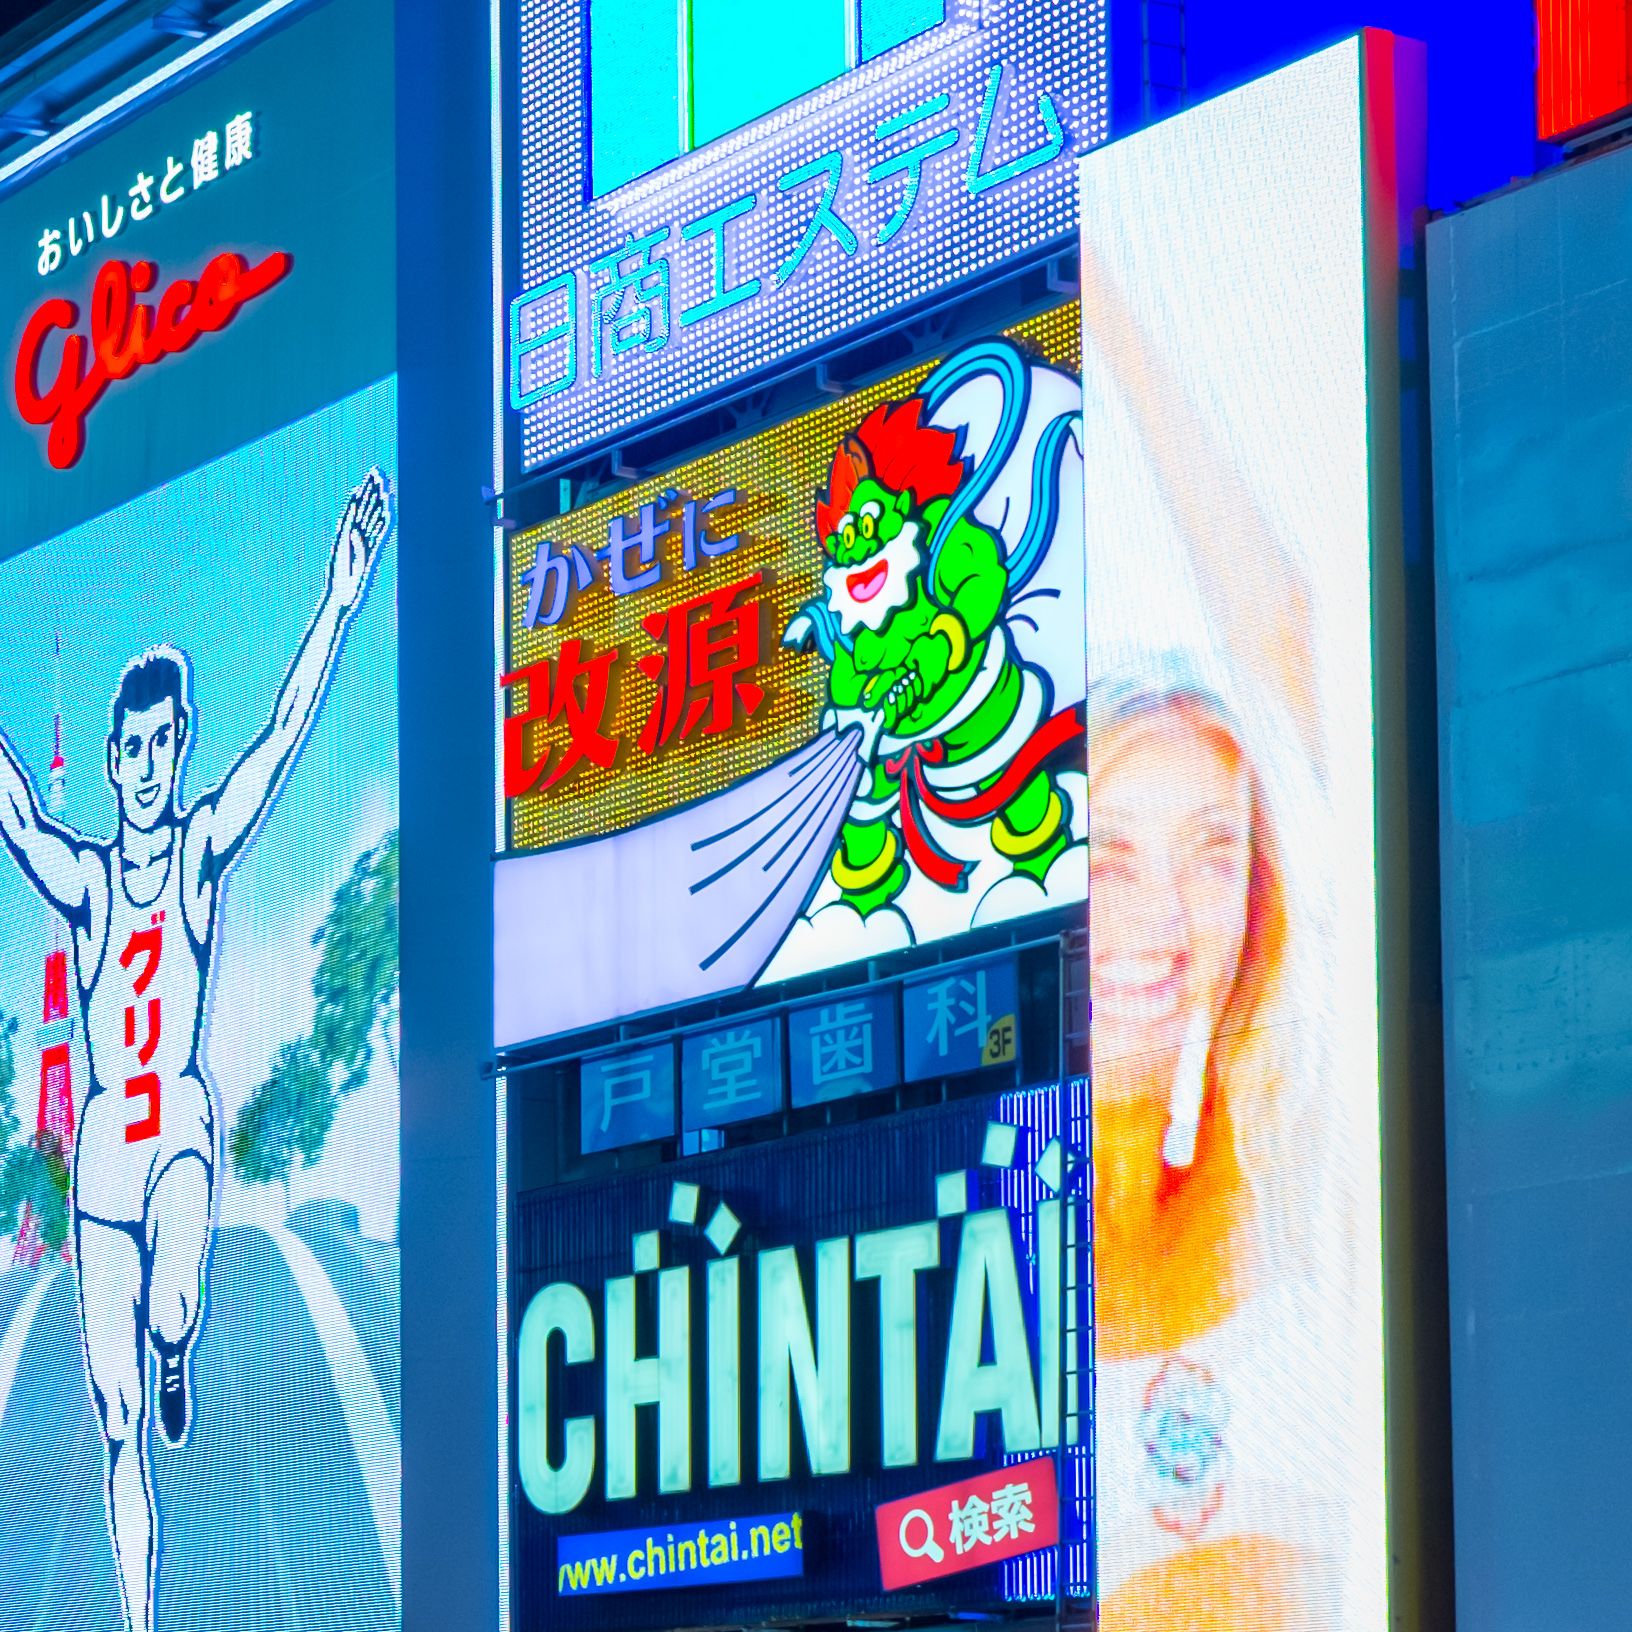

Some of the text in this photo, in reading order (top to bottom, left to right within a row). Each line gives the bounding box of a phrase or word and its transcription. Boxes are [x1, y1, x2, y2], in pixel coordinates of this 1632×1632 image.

[37, 111, 253, 275] おいしさと健康
[511, 65, 1064, 410] 日商エステム
[15, 251, 293, 470] Glico
[521, 487, 738, 630] かぜに
[501, 571, 766, 798] 改源
[119, 910, 166, 1144] グリコ
[600, 969, 1014, 1133] 戸堂歯科 3F
[518, 1170, 1077, 1514] CHINTAI
[948, 1481, 1036, 1555] 検索
